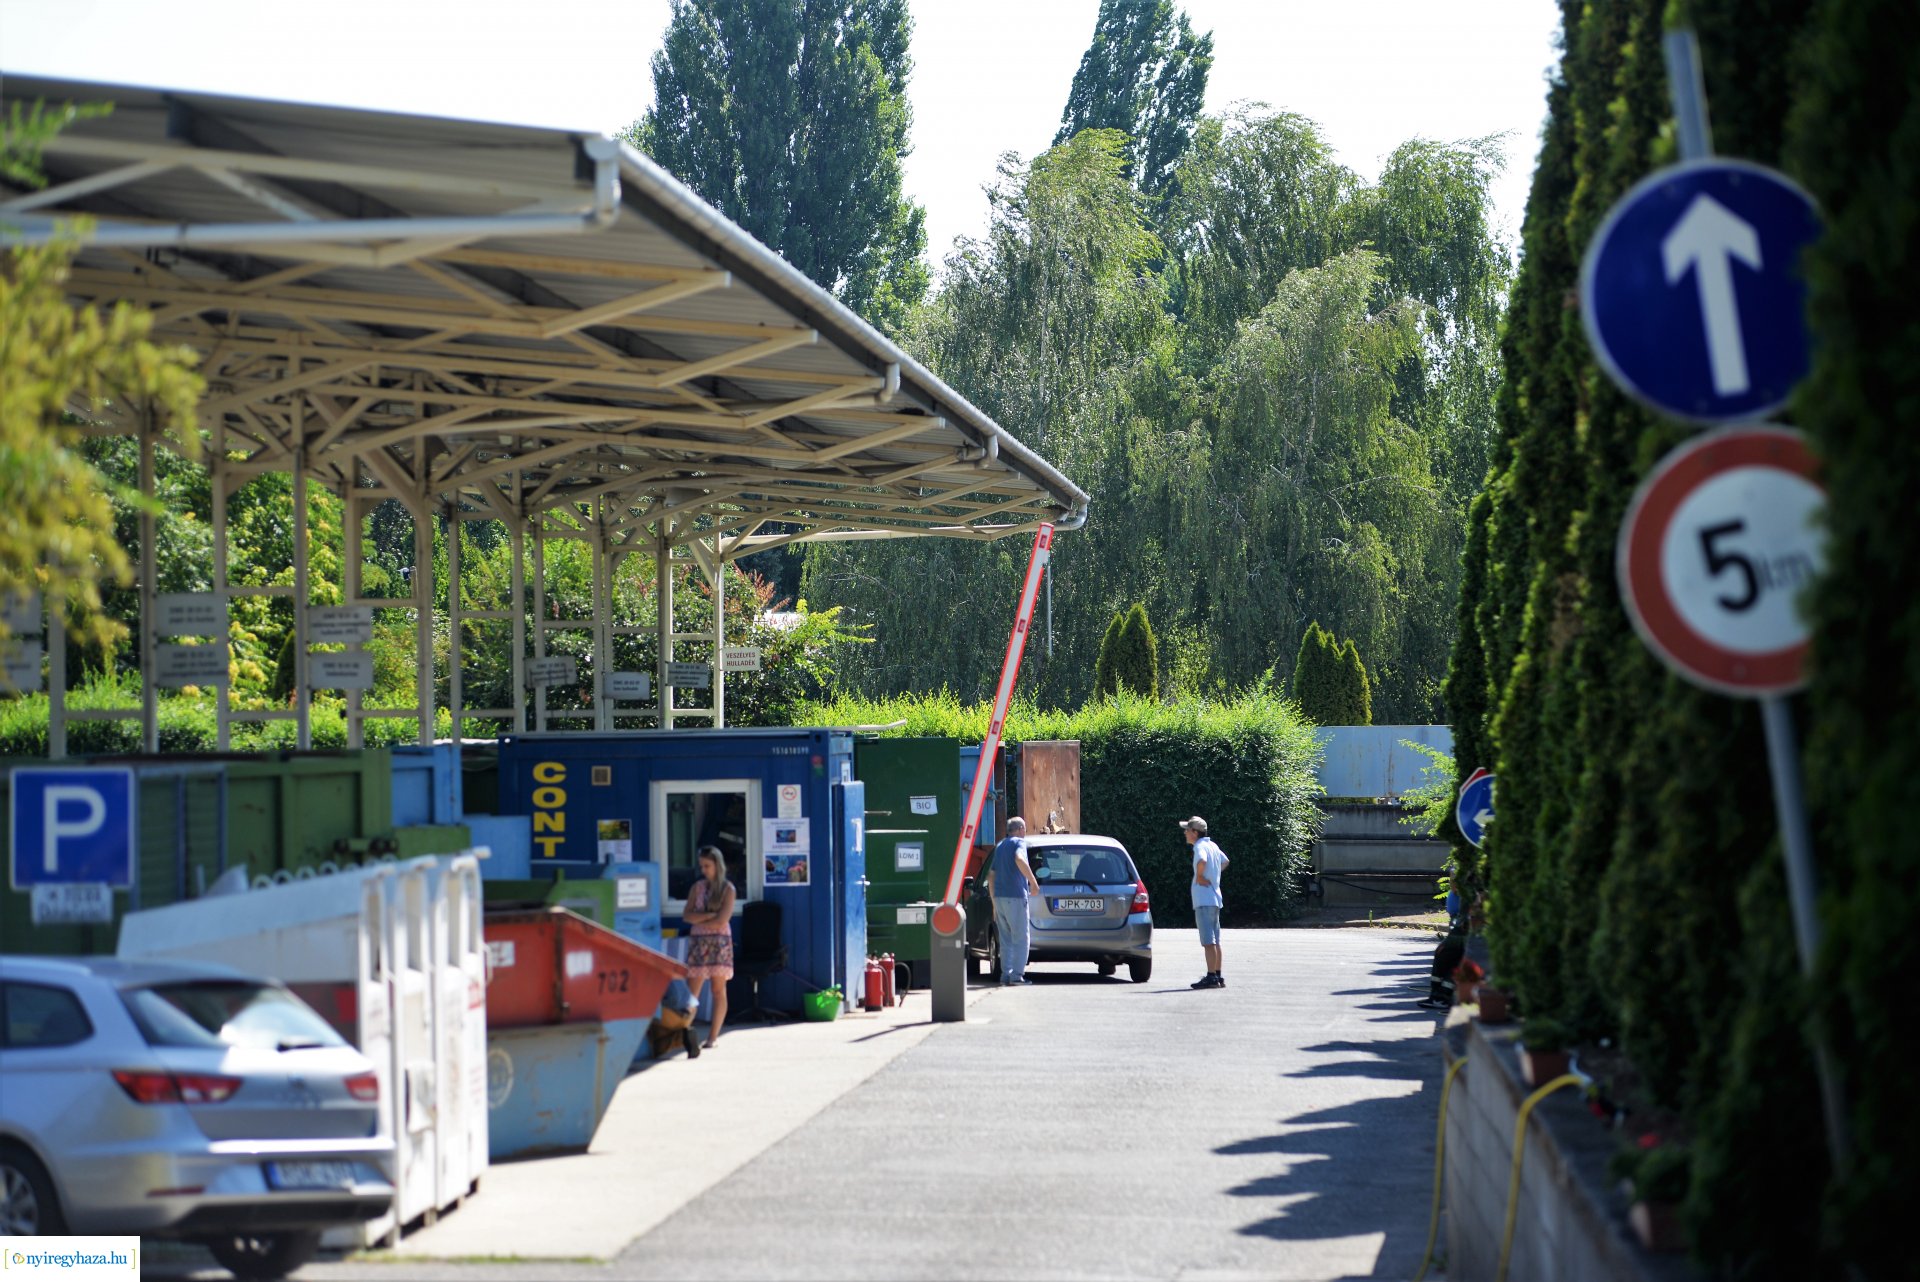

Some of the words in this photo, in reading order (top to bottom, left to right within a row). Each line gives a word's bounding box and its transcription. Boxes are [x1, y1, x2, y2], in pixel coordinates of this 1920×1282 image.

[1698, 517, 1760, 614] 5
[727, 659, 756, 667] HULLADÉK
[532, 761, 567, 857] CONT
[916, 802, 931, 810] BIO
[43, 785, 106, 872] P
[899, 852, 915, 860] LOM
[916, 852, 920, 860] 1
[1061, 900, 1102, 909] JPK-703
[598, 967, 630, 995] 702
